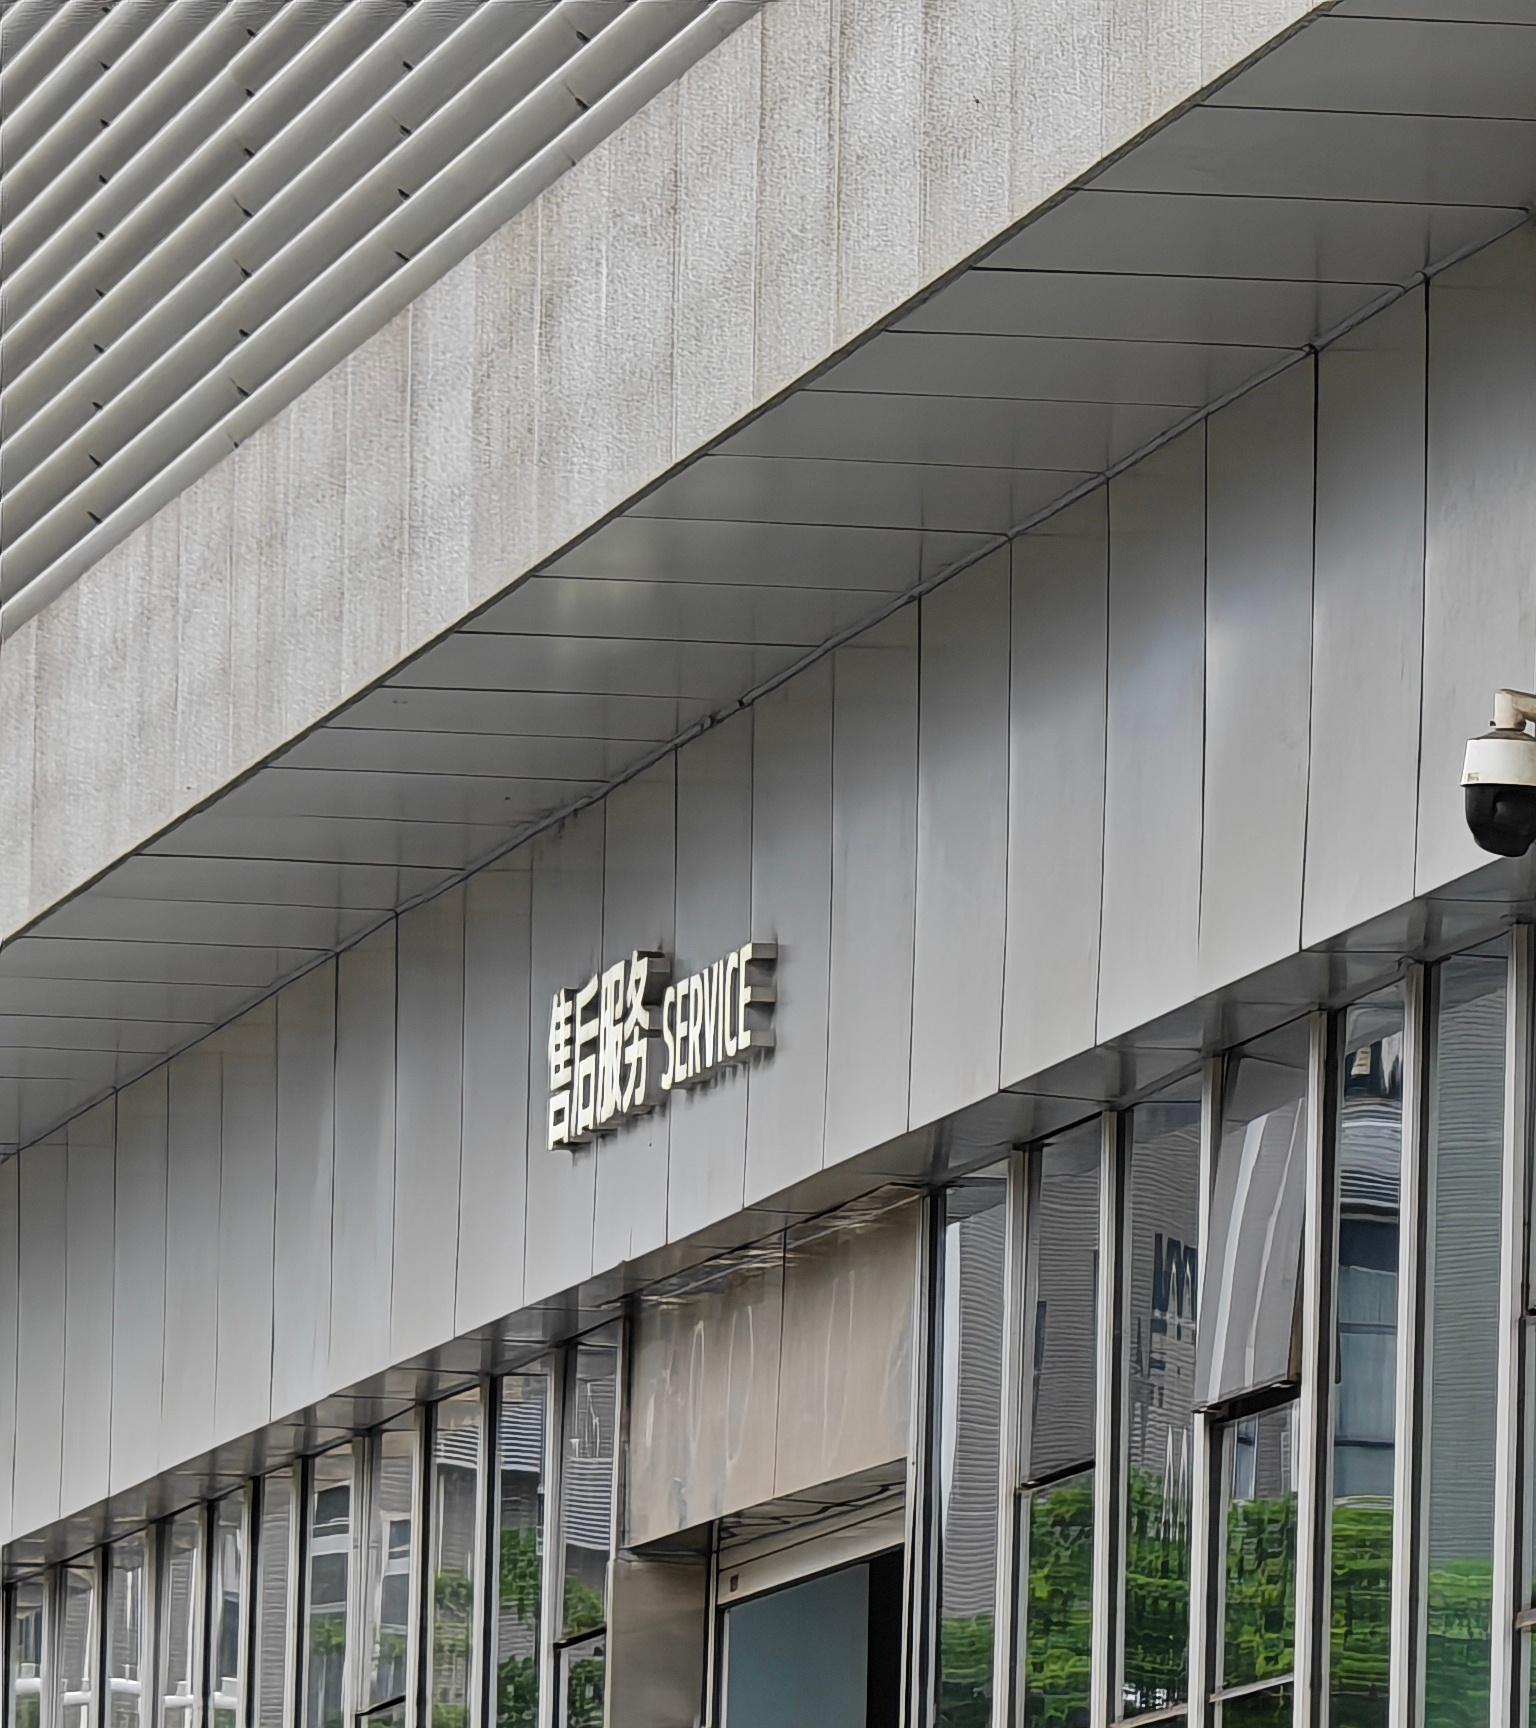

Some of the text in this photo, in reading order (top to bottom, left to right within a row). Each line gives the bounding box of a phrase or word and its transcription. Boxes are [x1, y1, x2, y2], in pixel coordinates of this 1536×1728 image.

[548, 942, 753, 1150] 售后服务 SERVICE
